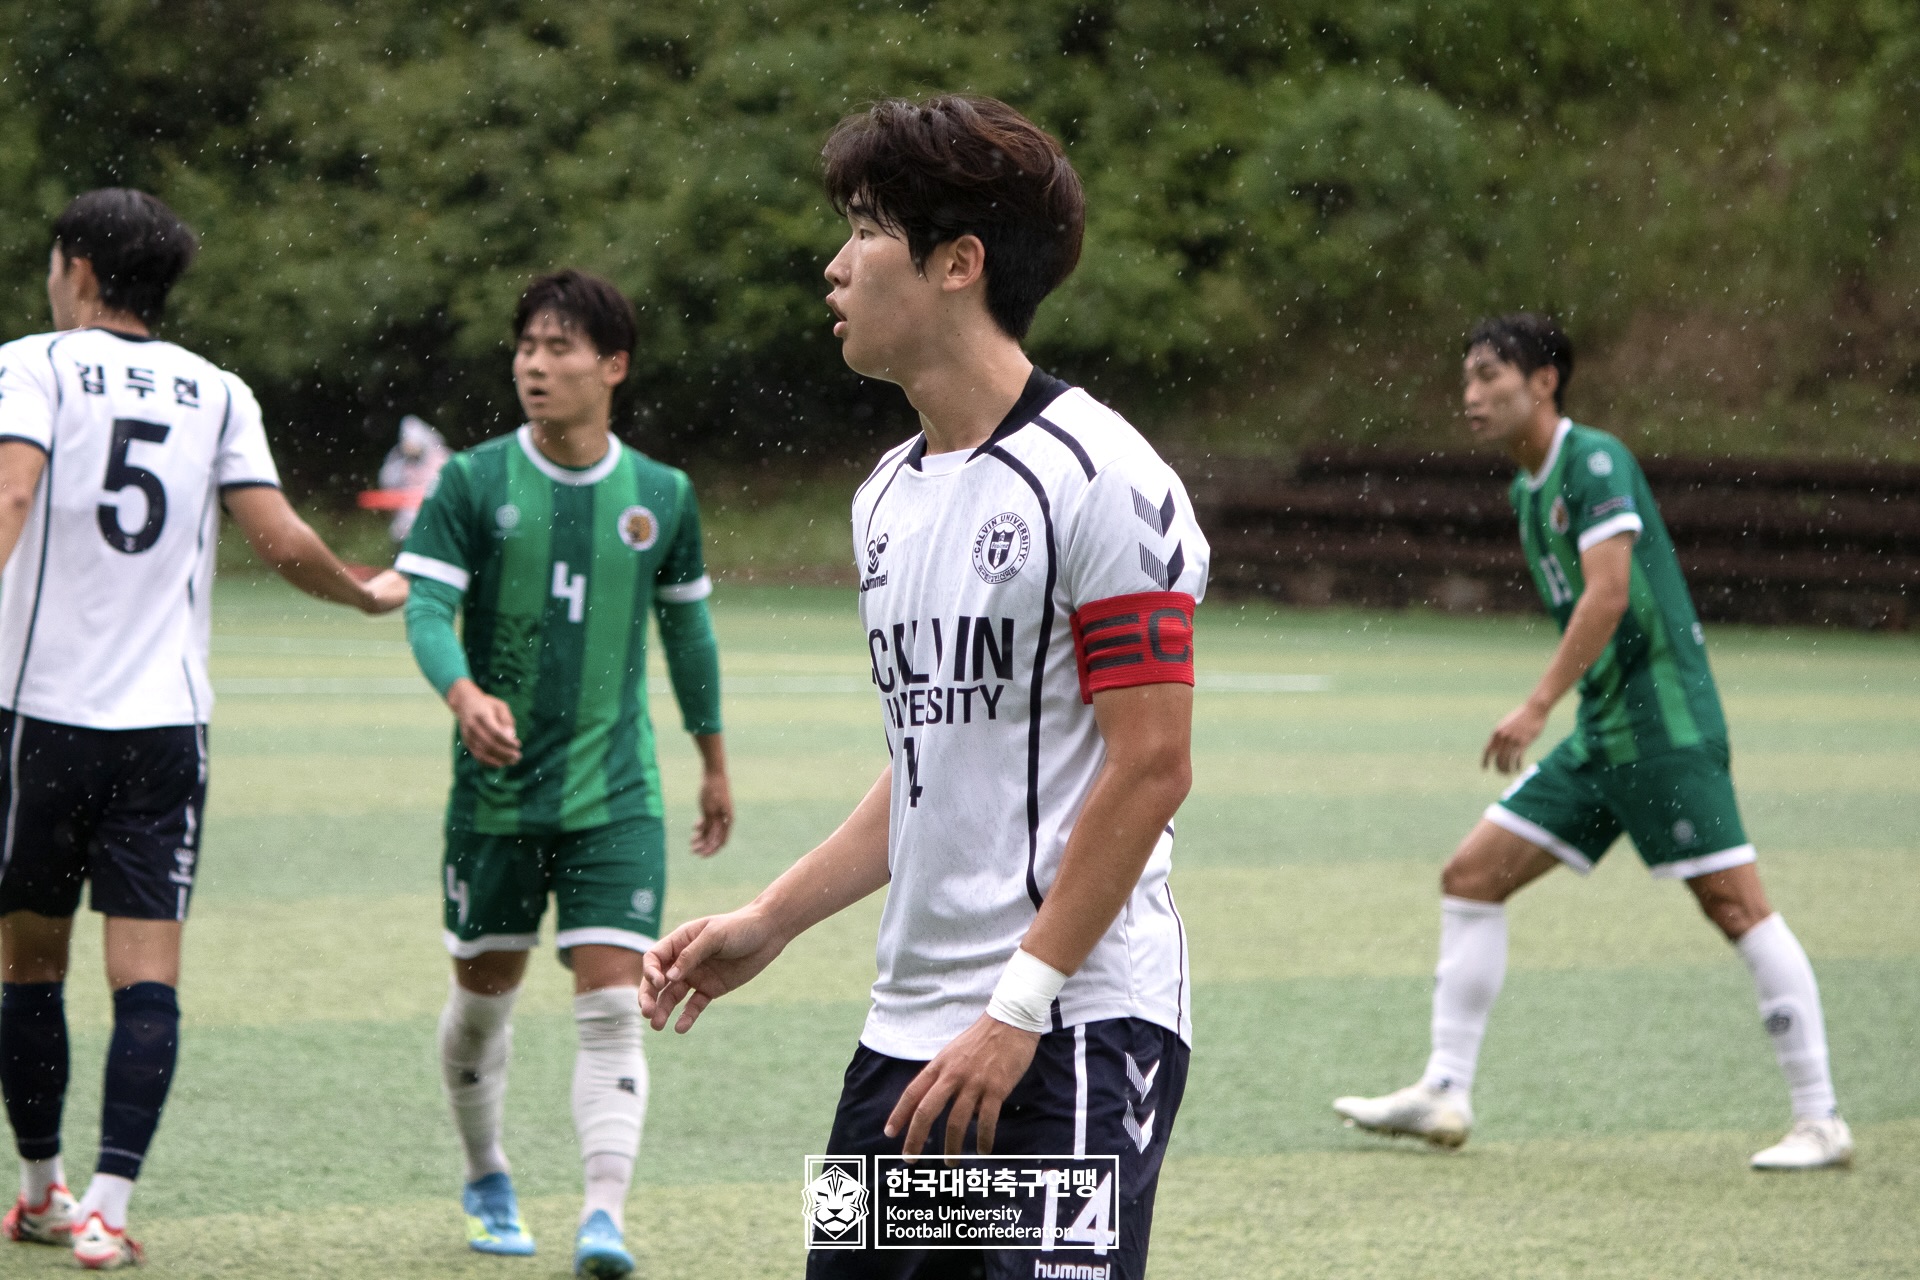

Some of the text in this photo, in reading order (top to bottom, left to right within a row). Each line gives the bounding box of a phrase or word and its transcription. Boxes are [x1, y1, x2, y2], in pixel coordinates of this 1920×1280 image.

[98, 418, 170, 554] 5
[974, 514, 1029, 560] CALVIN UNIVERSITY
[553, 560, 586, 623] 4
[447, 864, 469, 926] 4
[1041, 1170, 1116, 1256] 14
[1035, 1260, 1111, 1280] hummel
